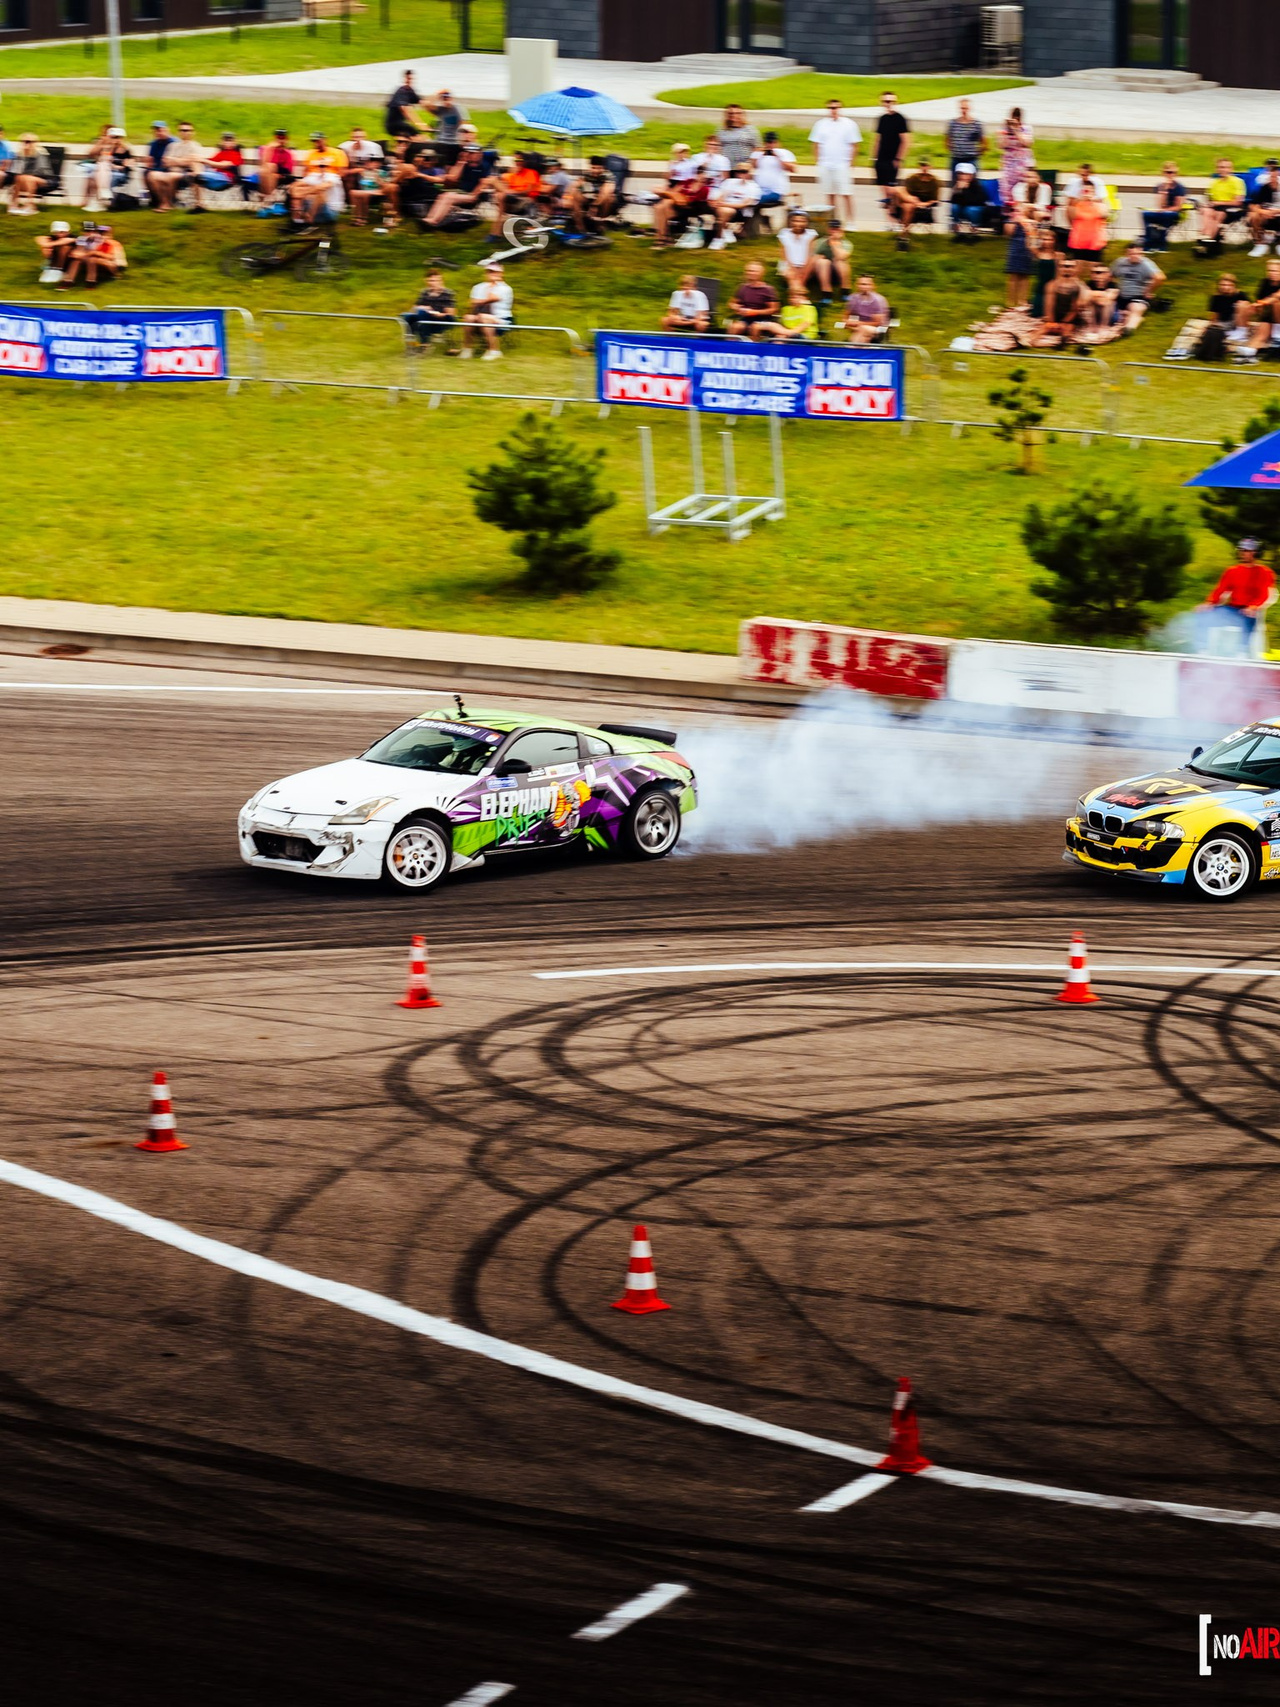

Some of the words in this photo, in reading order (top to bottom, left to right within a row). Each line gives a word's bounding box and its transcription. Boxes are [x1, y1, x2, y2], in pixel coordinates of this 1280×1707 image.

[144, 349, 219, 374] MOLY
[607, 345, 688, 375] LIQUI
[812, 360, 893, 387] LIQUI
[606, 371, 691, 404] MOLY
[810, 387, 895, 416] MOLY
[480, 786, 559, 821] ELEPHANT
